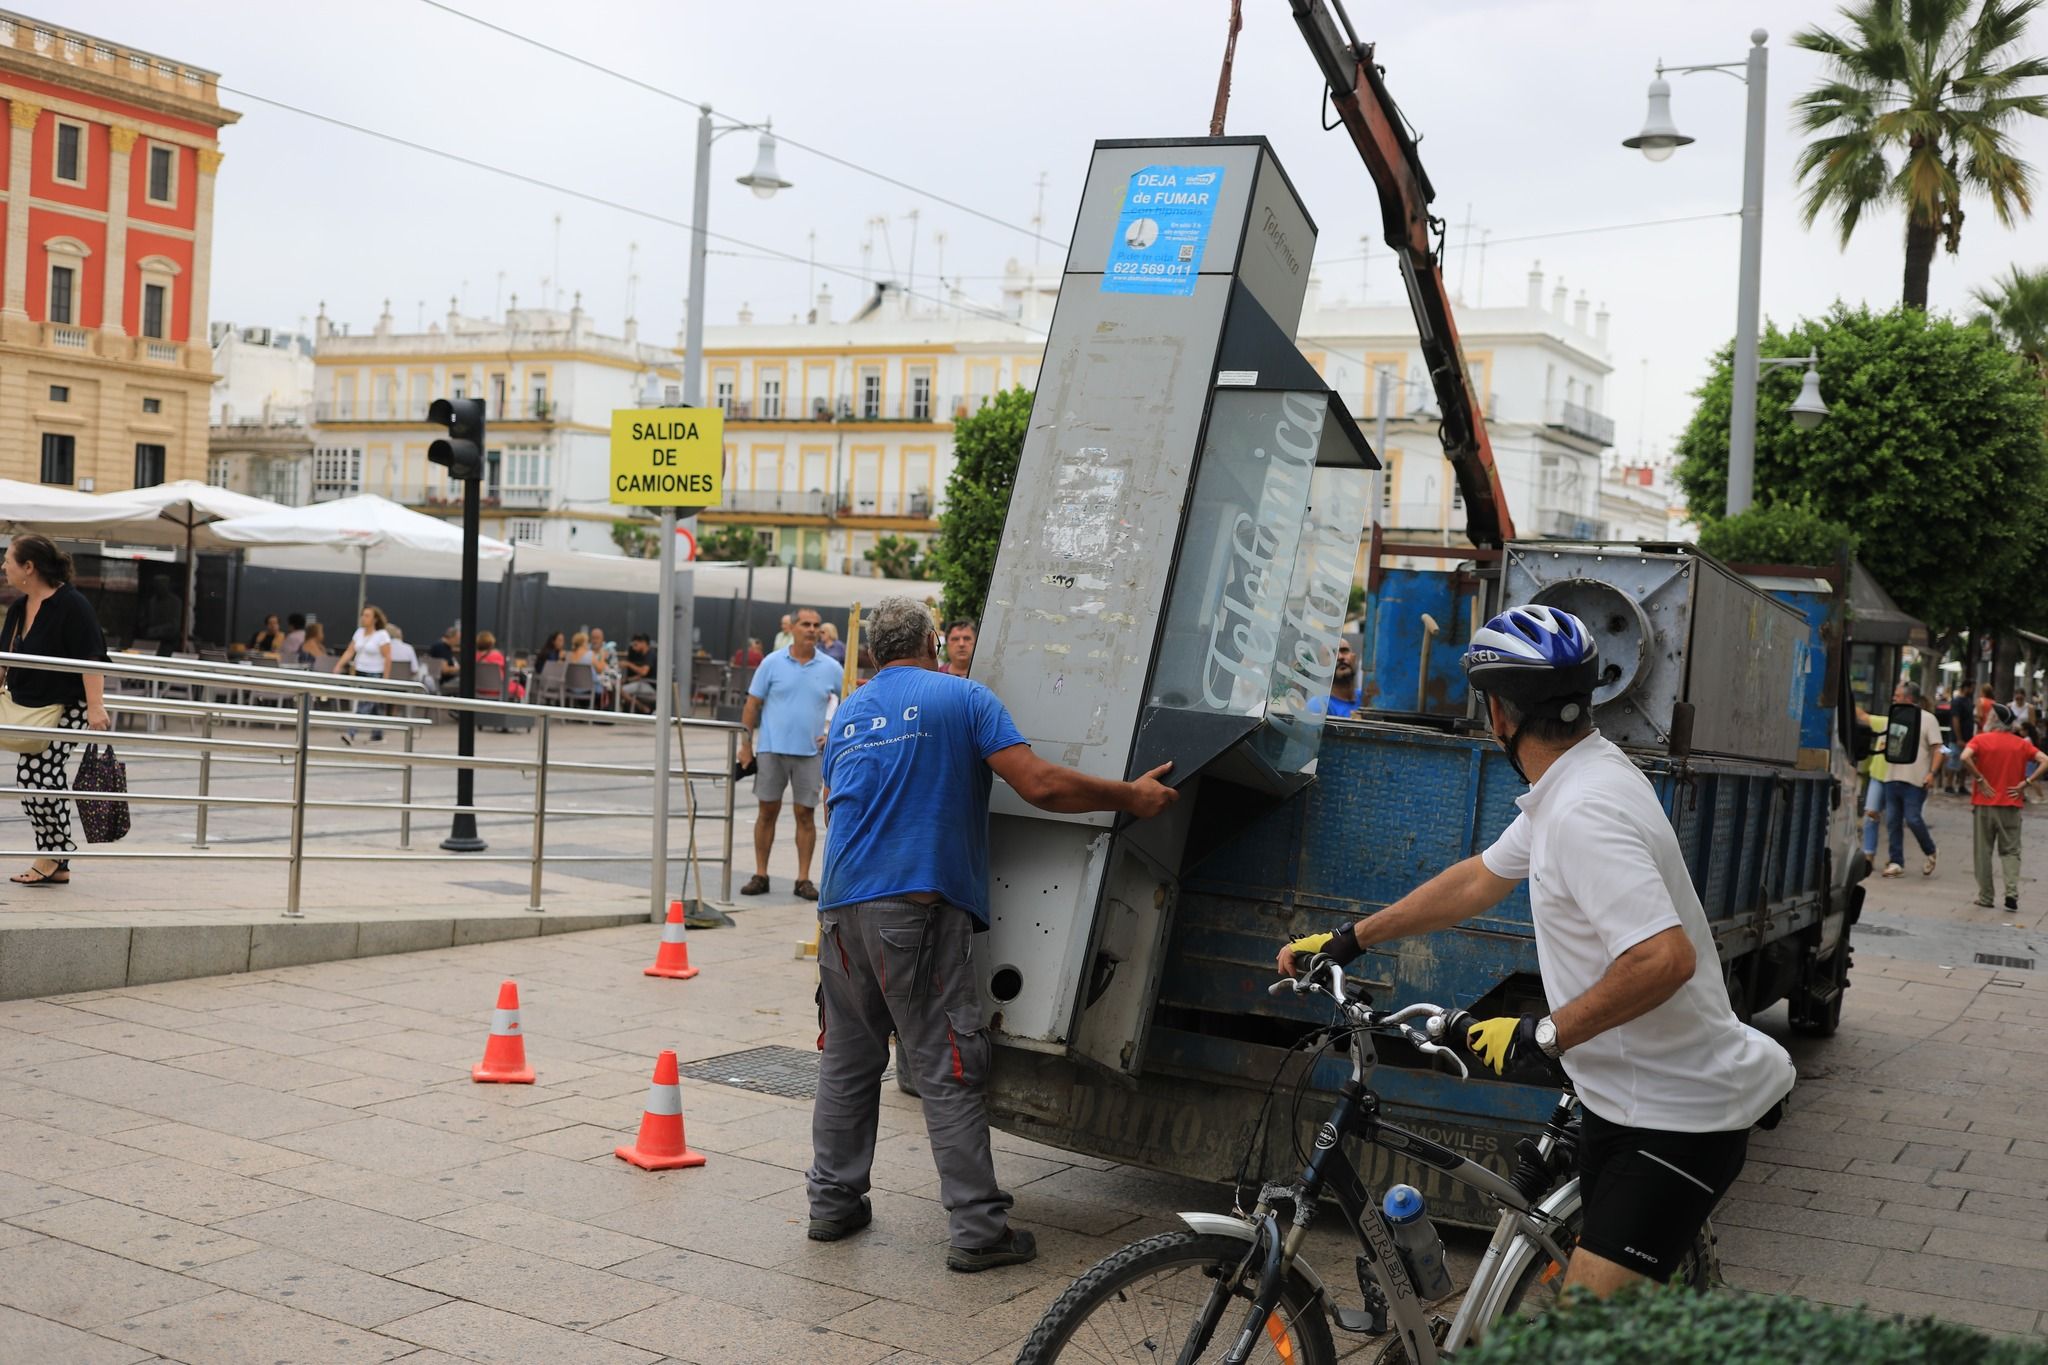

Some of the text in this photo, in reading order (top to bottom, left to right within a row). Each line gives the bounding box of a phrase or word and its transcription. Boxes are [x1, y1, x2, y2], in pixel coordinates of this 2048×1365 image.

[1137, 174, 1177, 187] DEJA
[1132, 192, 1210, 205] de FUMAR
[1113, 262, 1193, 277] 622 569 011
[632, 422, 699, 440] SALIDA
[653, 448, 677, 466] DE
[616, 474, 713, 493] CAMIONES
[1363, 1209, 1413, 1300] TREK
